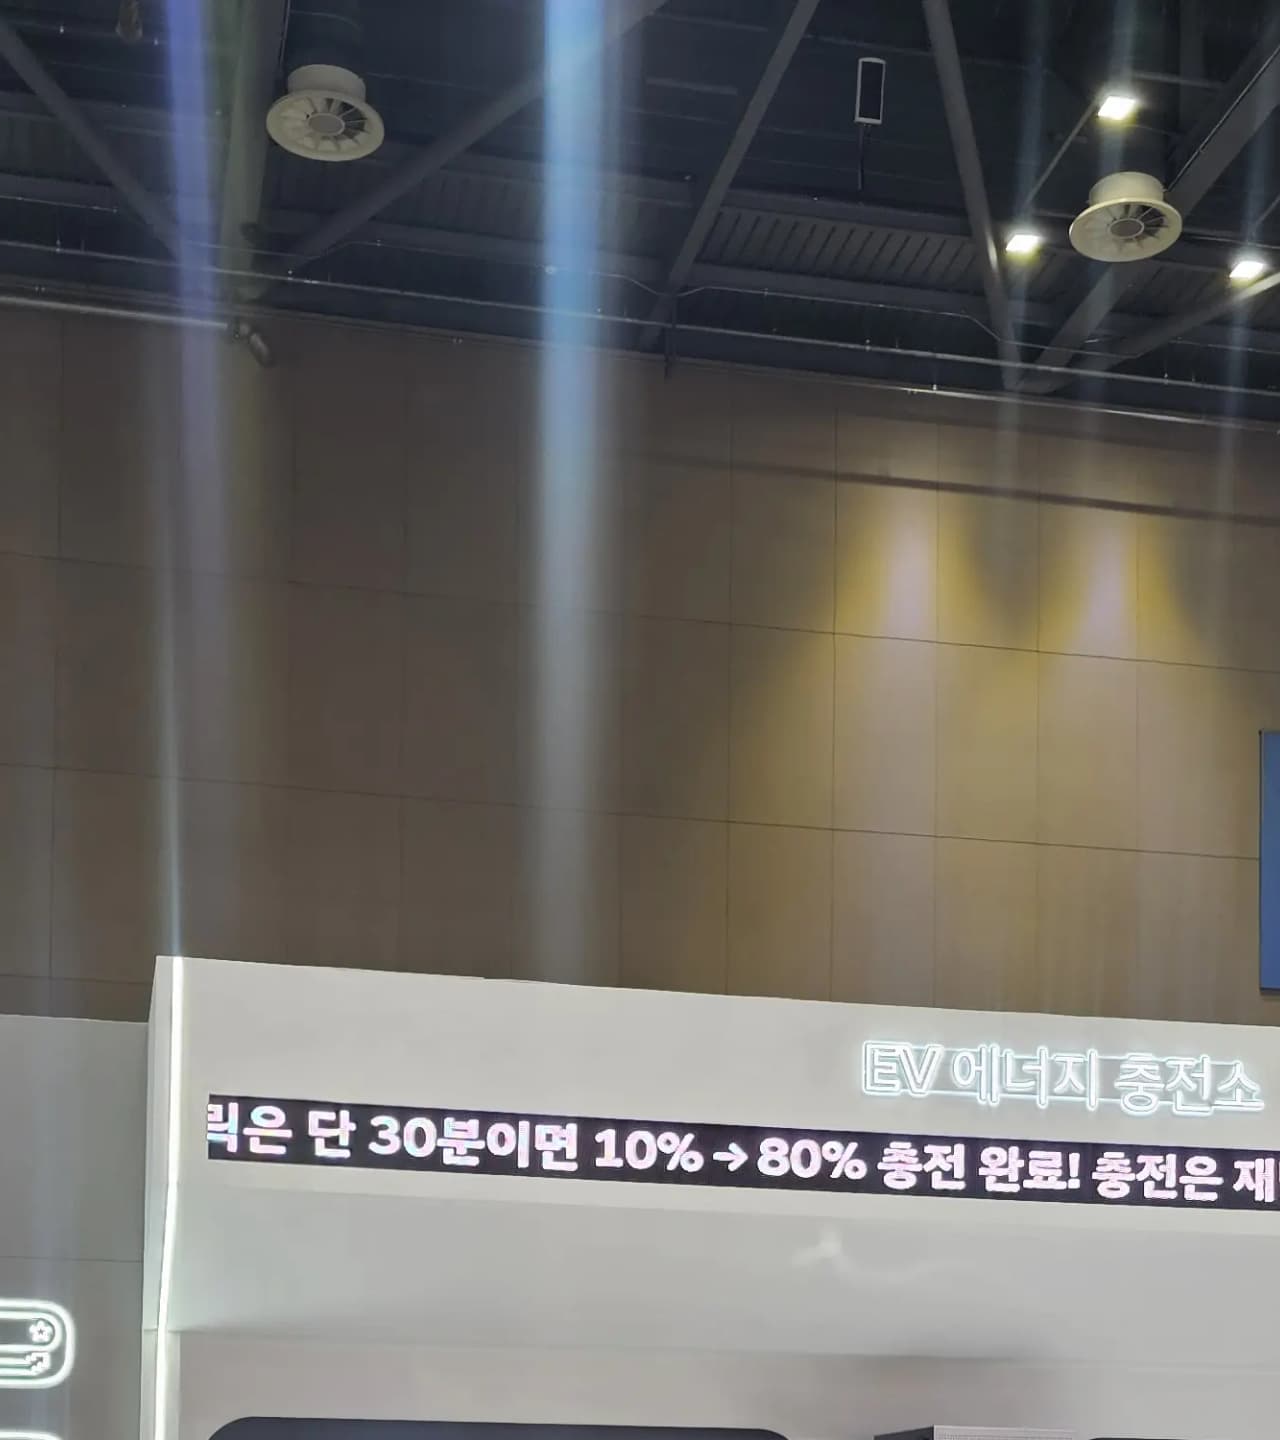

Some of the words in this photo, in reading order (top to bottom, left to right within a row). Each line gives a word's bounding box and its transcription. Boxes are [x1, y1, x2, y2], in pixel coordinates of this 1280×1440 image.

[862, 1040, 944, 1096] EV
[952, 1043, 1099, 1110] 에너지
[1114, 1053, 1267, 1115] 충전소
[308, 1109, 357, 1159] 단
[369, 1115, 579, 1172] 30분이면
[594, 1128, 705, 1173] 10%
[757, 1136, 868, 1181] 80%
[877, 1141, 967, 1191] 충전
[978, 1146, 1081, 1192] 완료!
[1092, 1151, 1223, 1202] 충전은
